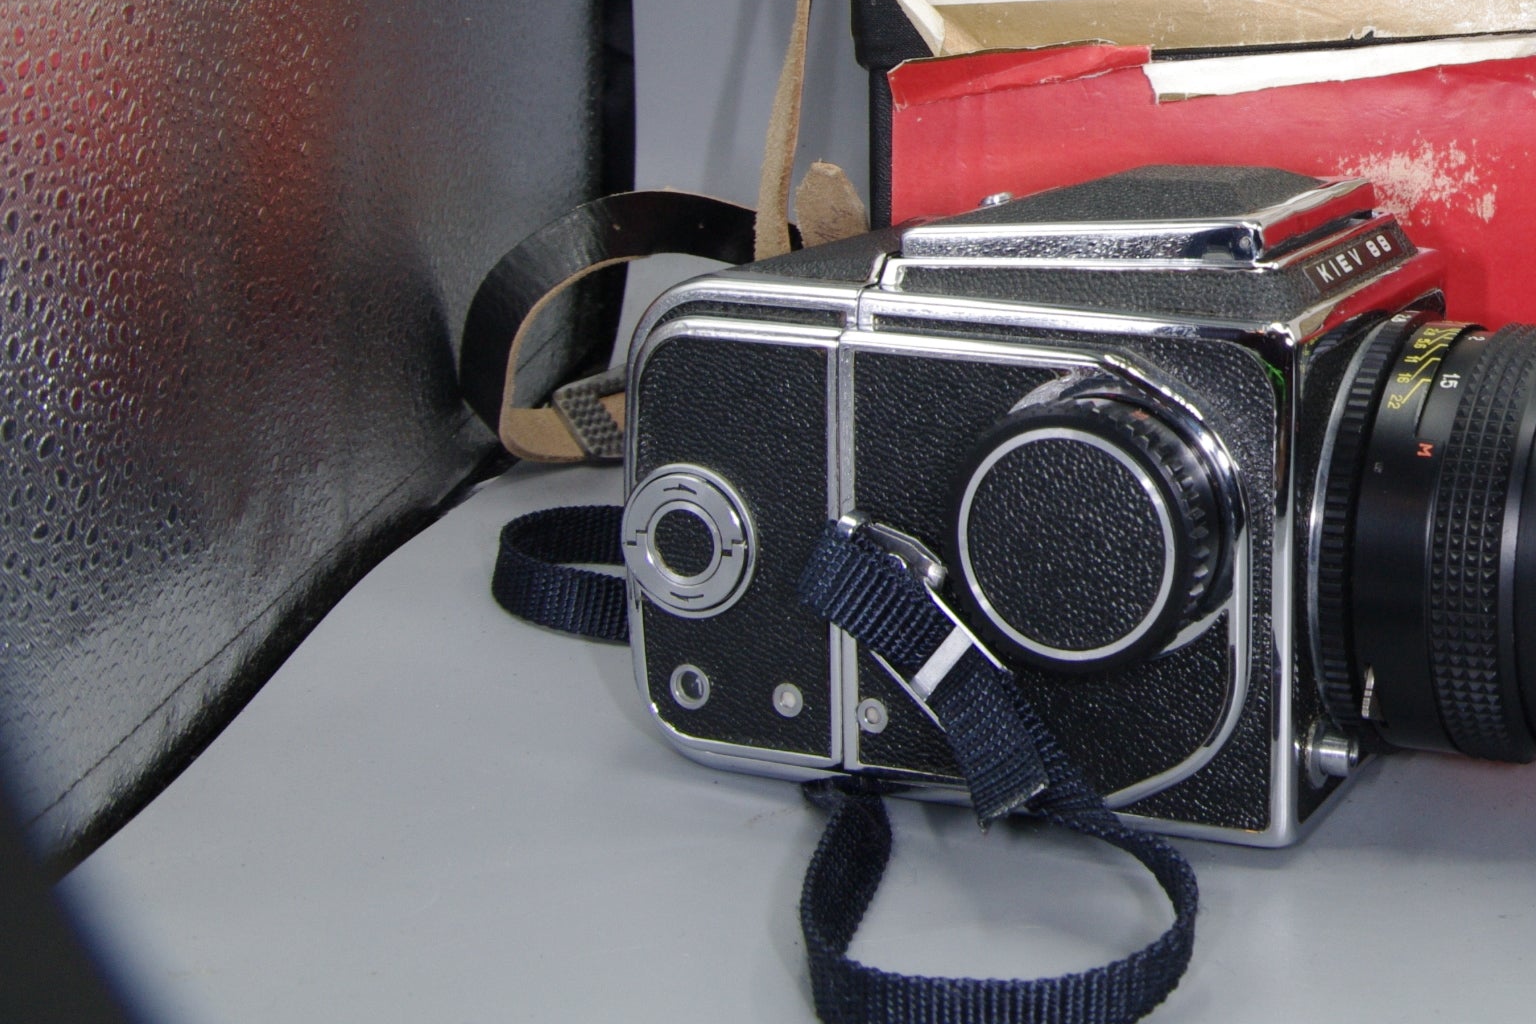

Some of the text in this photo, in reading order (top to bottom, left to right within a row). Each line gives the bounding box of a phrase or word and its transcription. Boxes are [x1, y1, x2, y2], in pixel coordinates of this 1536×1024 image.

[1316, 235, 1392, 283] KIEV 88
[1396, 373, 1412, 385] 16
[1387, 394, 1403, 410] 22
[1417, 442, 1435, 458] M
